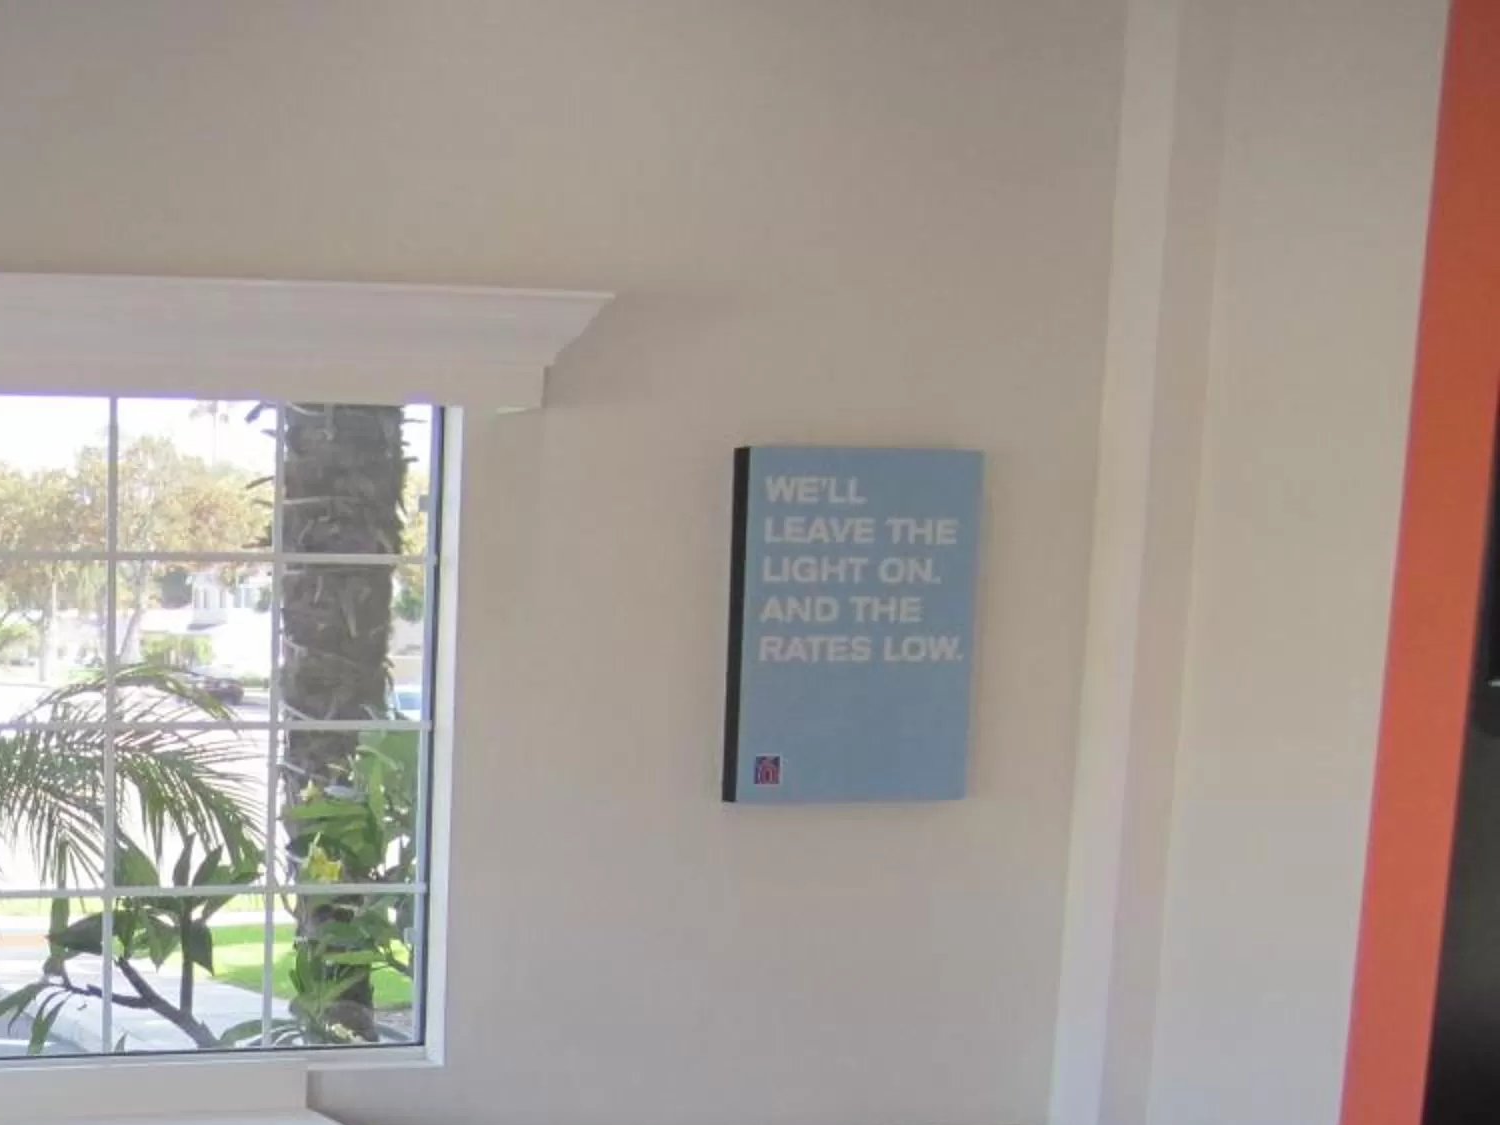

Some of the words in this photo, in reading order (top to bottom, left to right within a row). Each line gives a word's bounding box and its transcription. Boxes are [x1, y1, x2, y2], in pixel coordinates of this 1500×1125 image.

[765, 476, 867, 504] WE'LL
[763, 516, 876, 545] LEAVE
[885, 517, 958, 546] THE
[761, 556, 869, 583] LIGHT
[878, 556, 941, 584] ON.
[759, 595, 839, 623] AND
[847, 595, 923, 623] THE
[757, 635, 872, 663] RATES
[882, 636, 965, 663] LOW.
